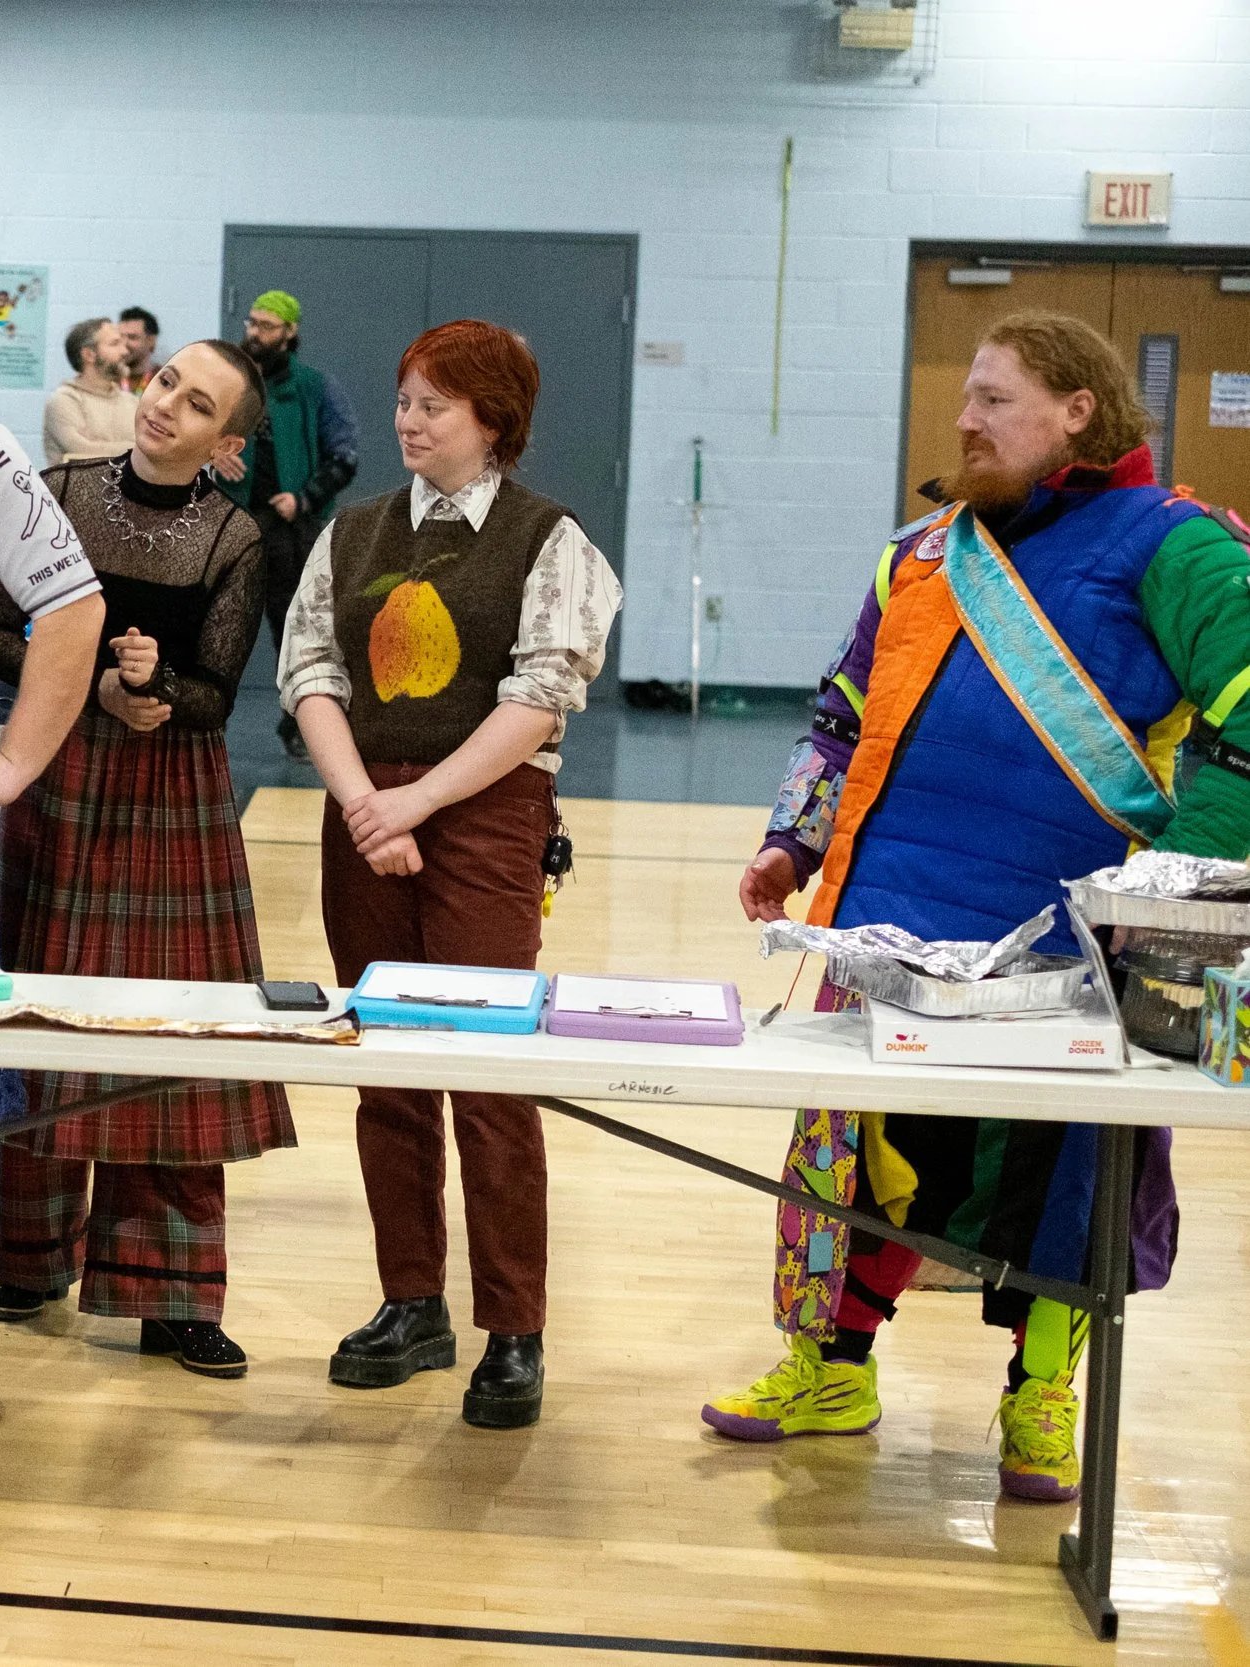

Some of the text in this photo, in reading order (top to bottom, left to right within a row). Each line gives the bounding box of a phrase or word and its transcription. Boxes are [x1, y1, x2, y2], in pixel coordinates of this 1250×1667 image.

[1104, 183, 1151, 219] EXIT
[27, 566, 53, 586] THIS
[53, 552, 82, 573] WE'LL
[1068, 1047, 1105, 1055] DONUTS
